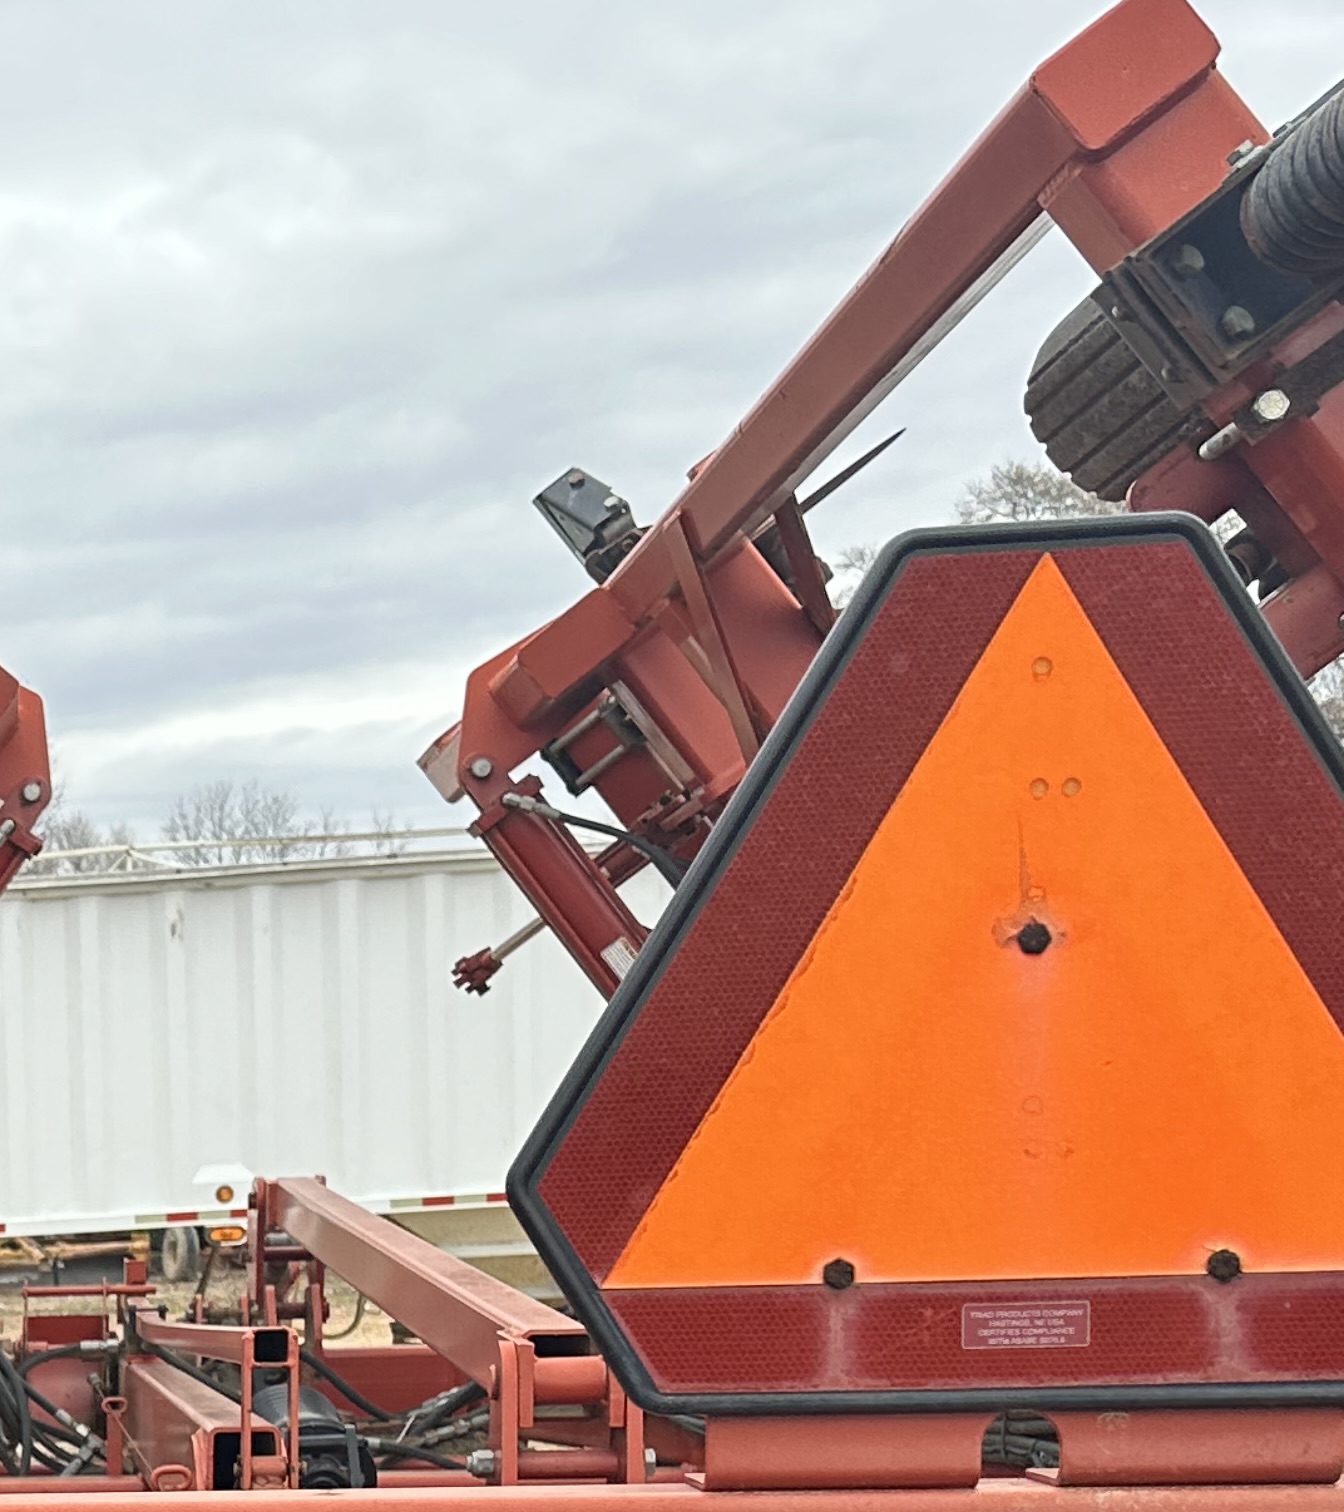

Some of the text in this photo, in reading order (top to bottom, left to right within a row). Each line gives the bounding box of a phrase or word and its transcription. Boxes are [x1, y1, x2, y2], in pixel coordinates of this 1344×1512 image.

[995, 1310, 1041, 1318] PRODUCTS
[1042, 1308, 1084, 1317] COMPANY
[1047, 1318, 1065, 1326] USA
[977, 1327, 1075, 1335] CERTIFIES COMPLIANCE
[987, 1336, 1010, 1344] WITH
